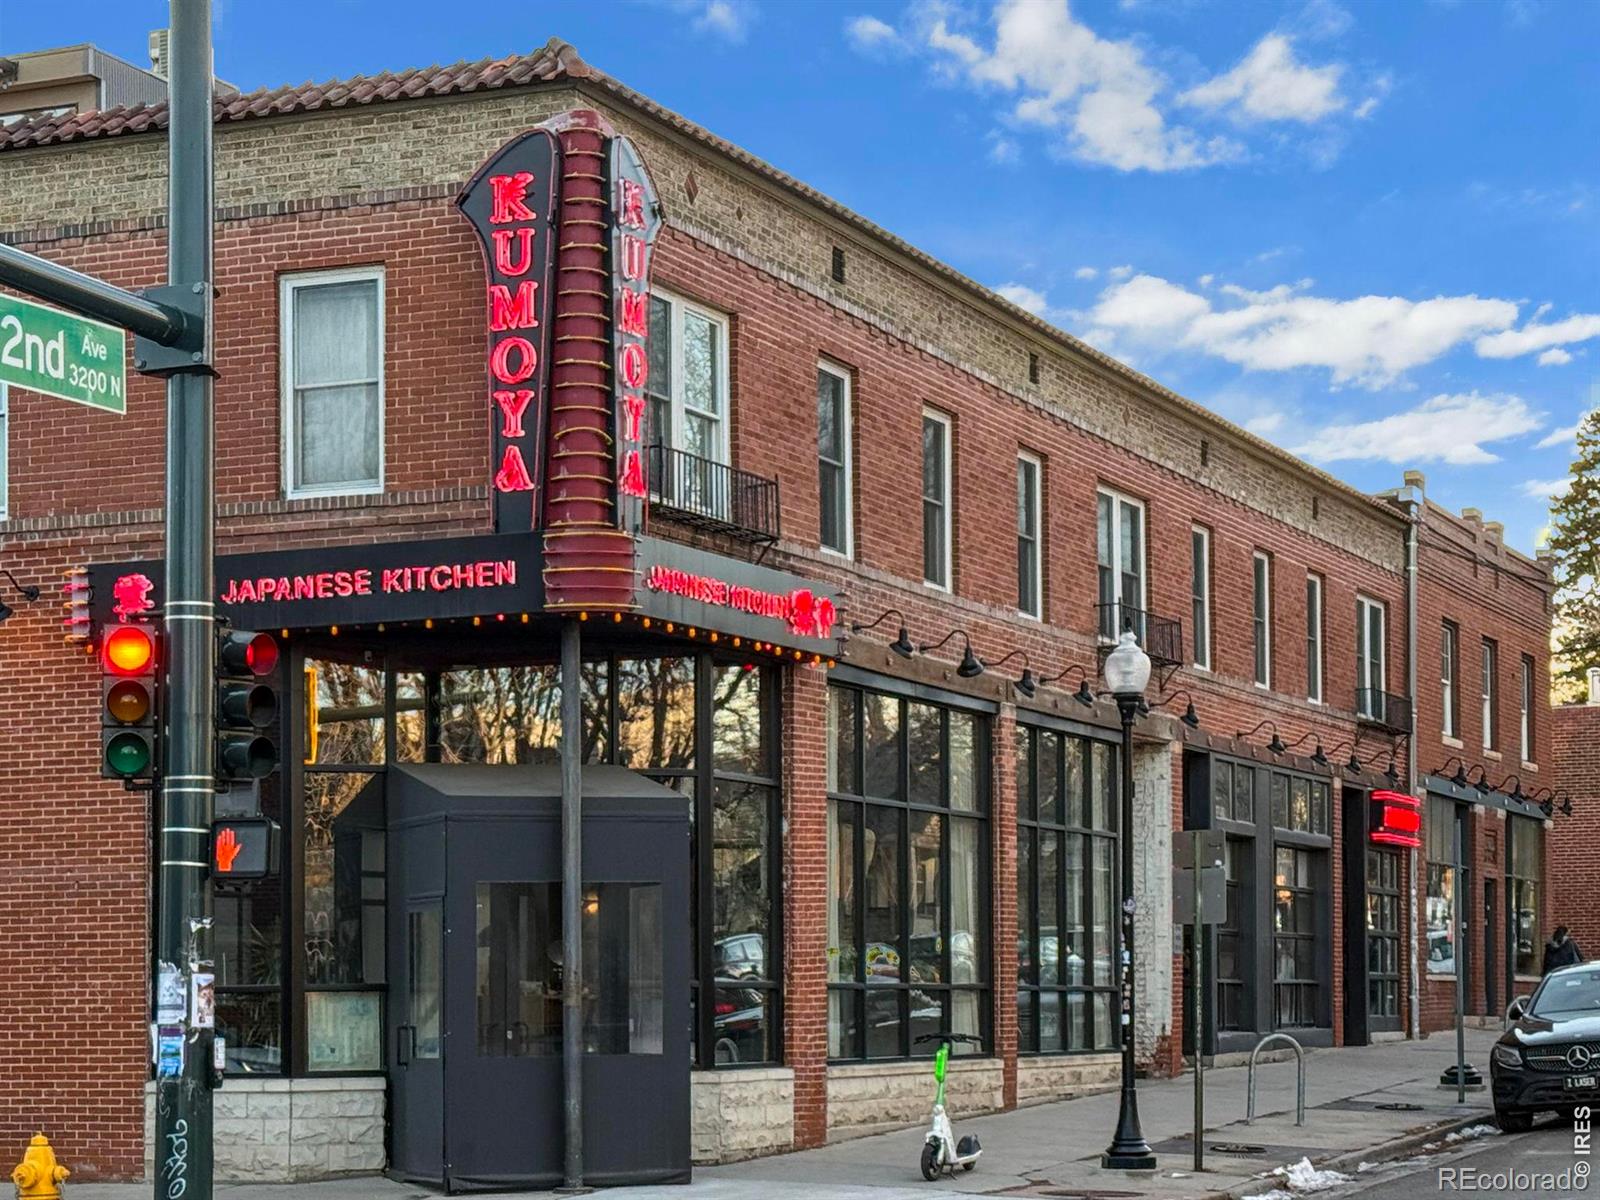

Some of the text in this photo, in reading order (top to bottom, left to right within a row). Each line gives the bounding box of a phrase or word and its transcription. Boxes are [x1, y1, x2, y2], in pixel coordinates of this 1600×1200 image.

[1, 314, 108, 380] 2nd Ave
[488, 170, 538, 494] KUMOYA
[618, 178, 649, 499] KUMOYA
[69, 363, 121, 398] 3200 N
[221, 559, 517, 605] JAPANESE KITCHEN
[647, 565, 727, 606] JAPANESE
